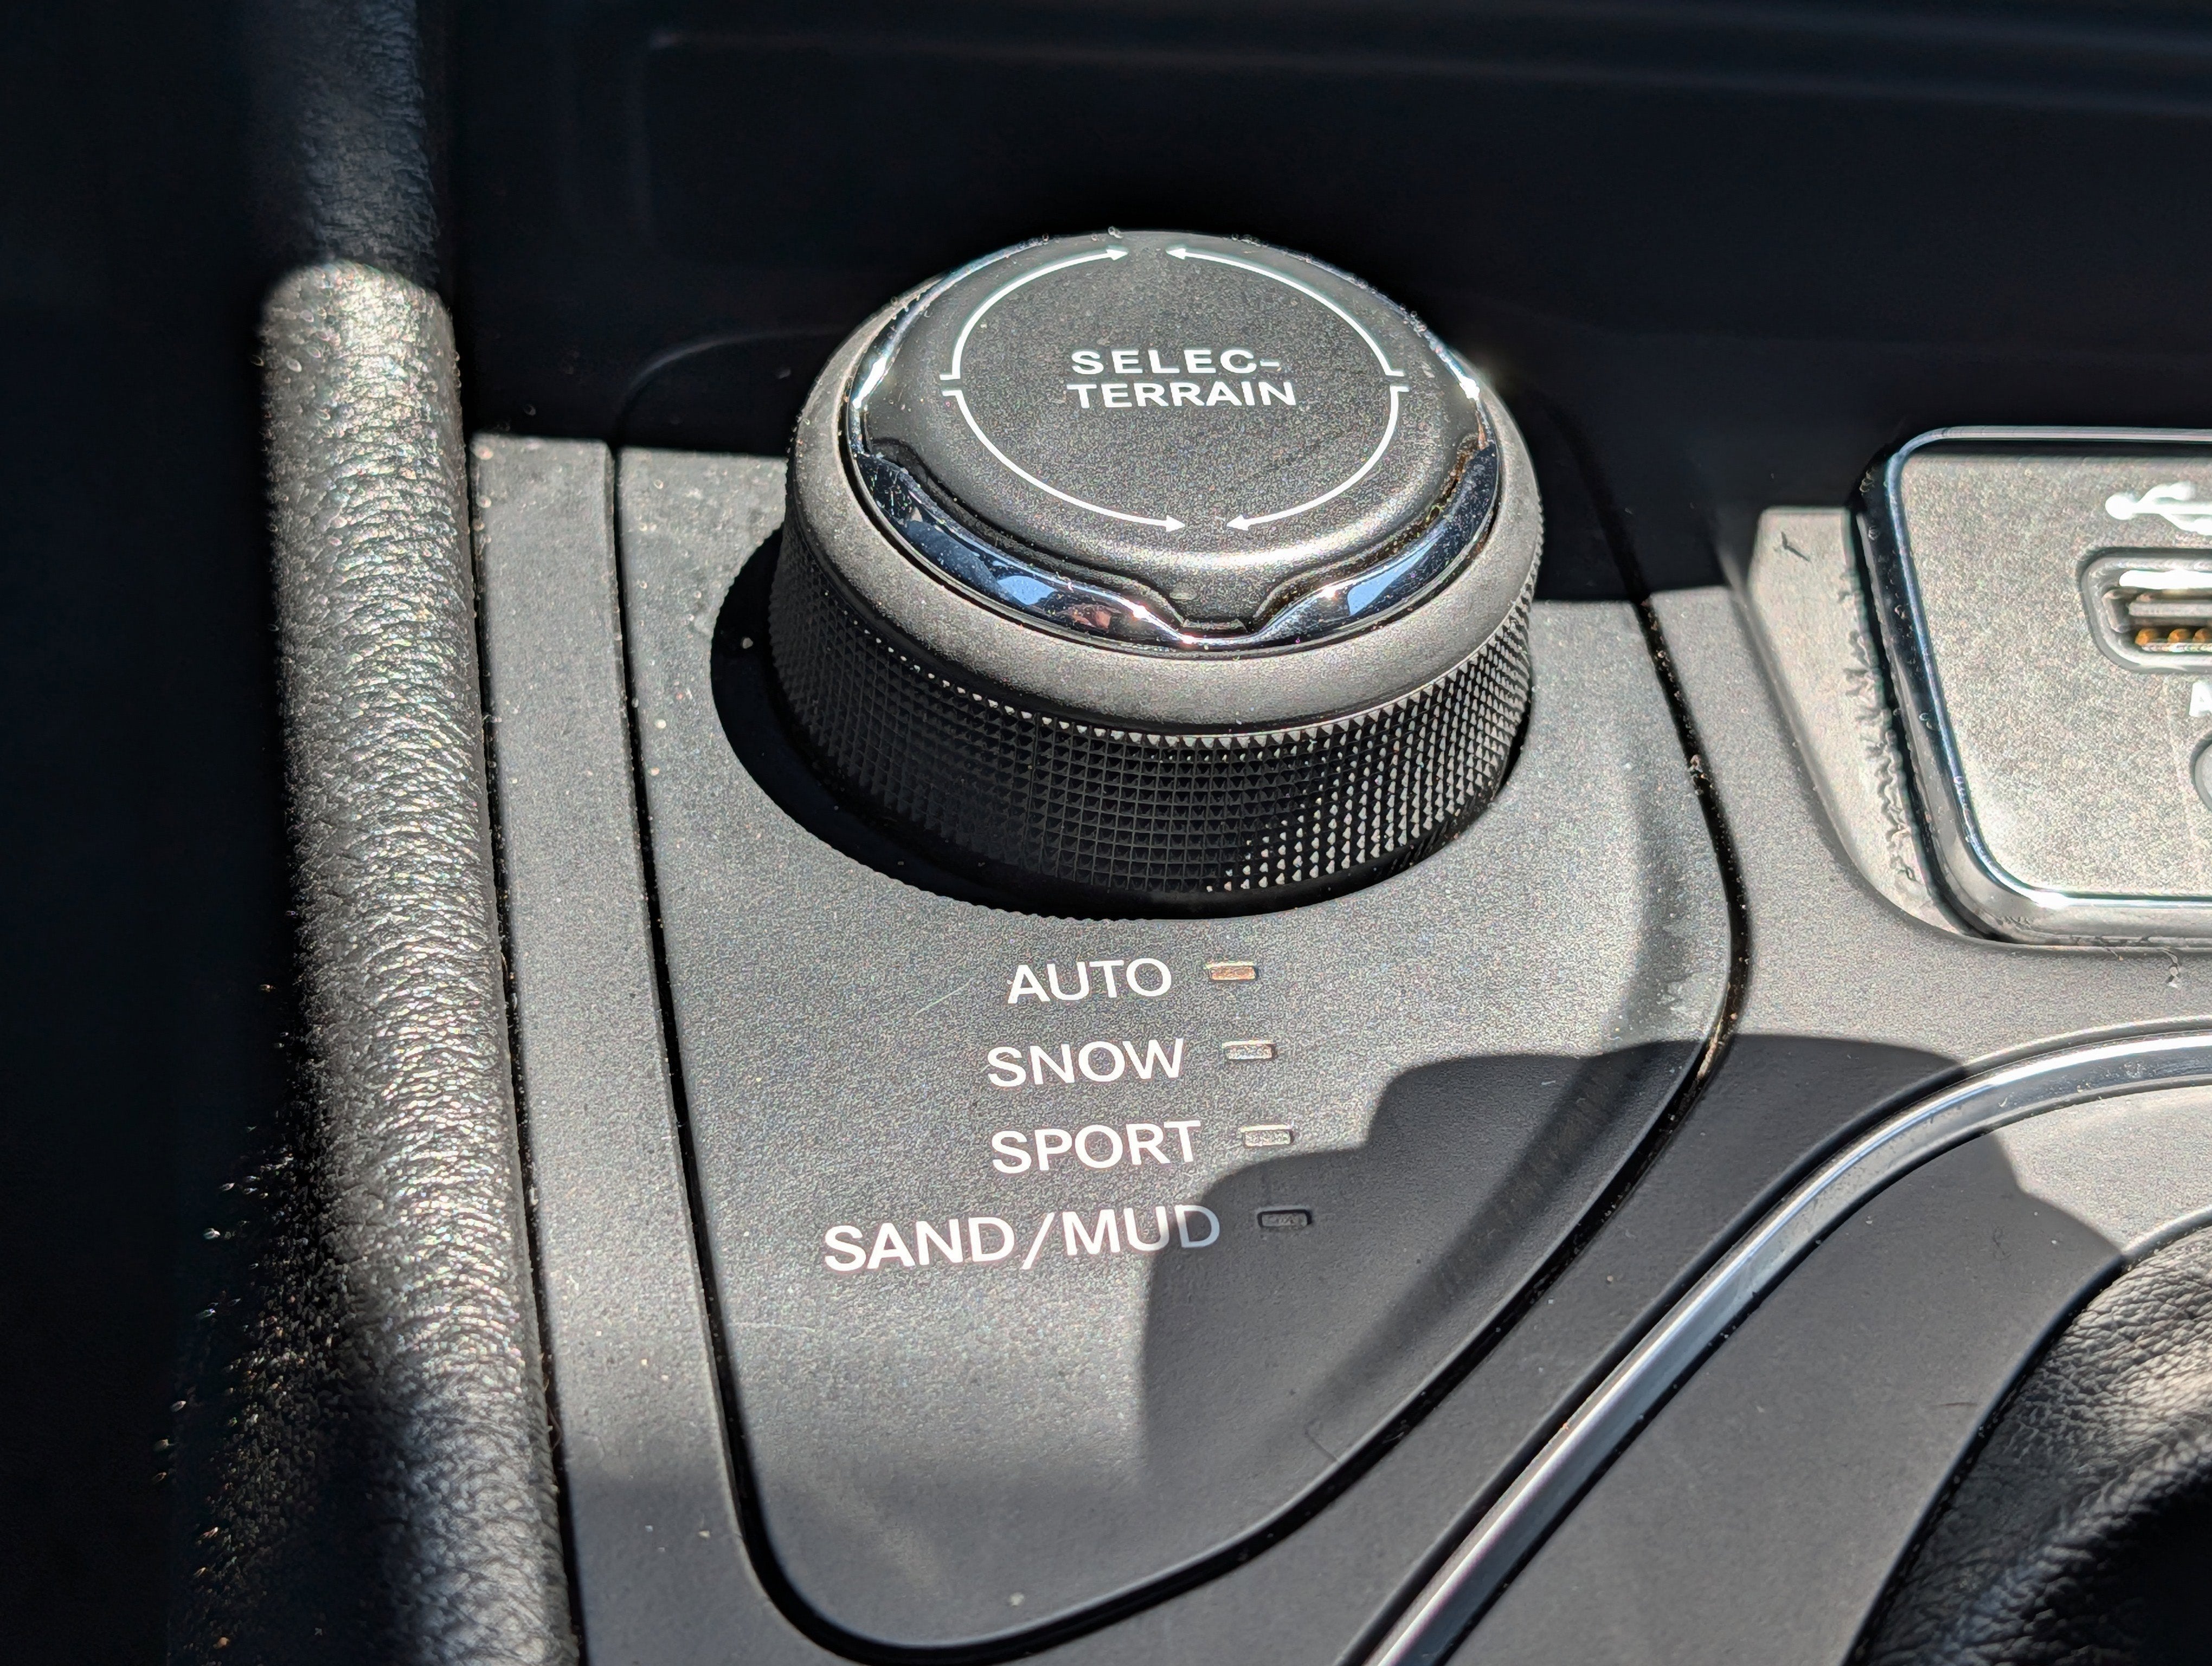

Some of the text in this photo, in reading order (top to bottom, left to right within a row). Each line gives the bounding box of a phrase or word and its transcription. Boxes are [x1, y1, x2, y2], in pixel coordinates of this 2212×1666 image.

[1071, 349, 1280, 374] SELEC-
[1066, 381, 1296, 408] TERRAIN
[1007, 958, 1171, 1004] AUTO
[987, 1038, 1184, 1087] SNOW
[991, 1120, 1201, 1174] SPORT
[824, 1204, 1220, 1271] SAND/MUD
